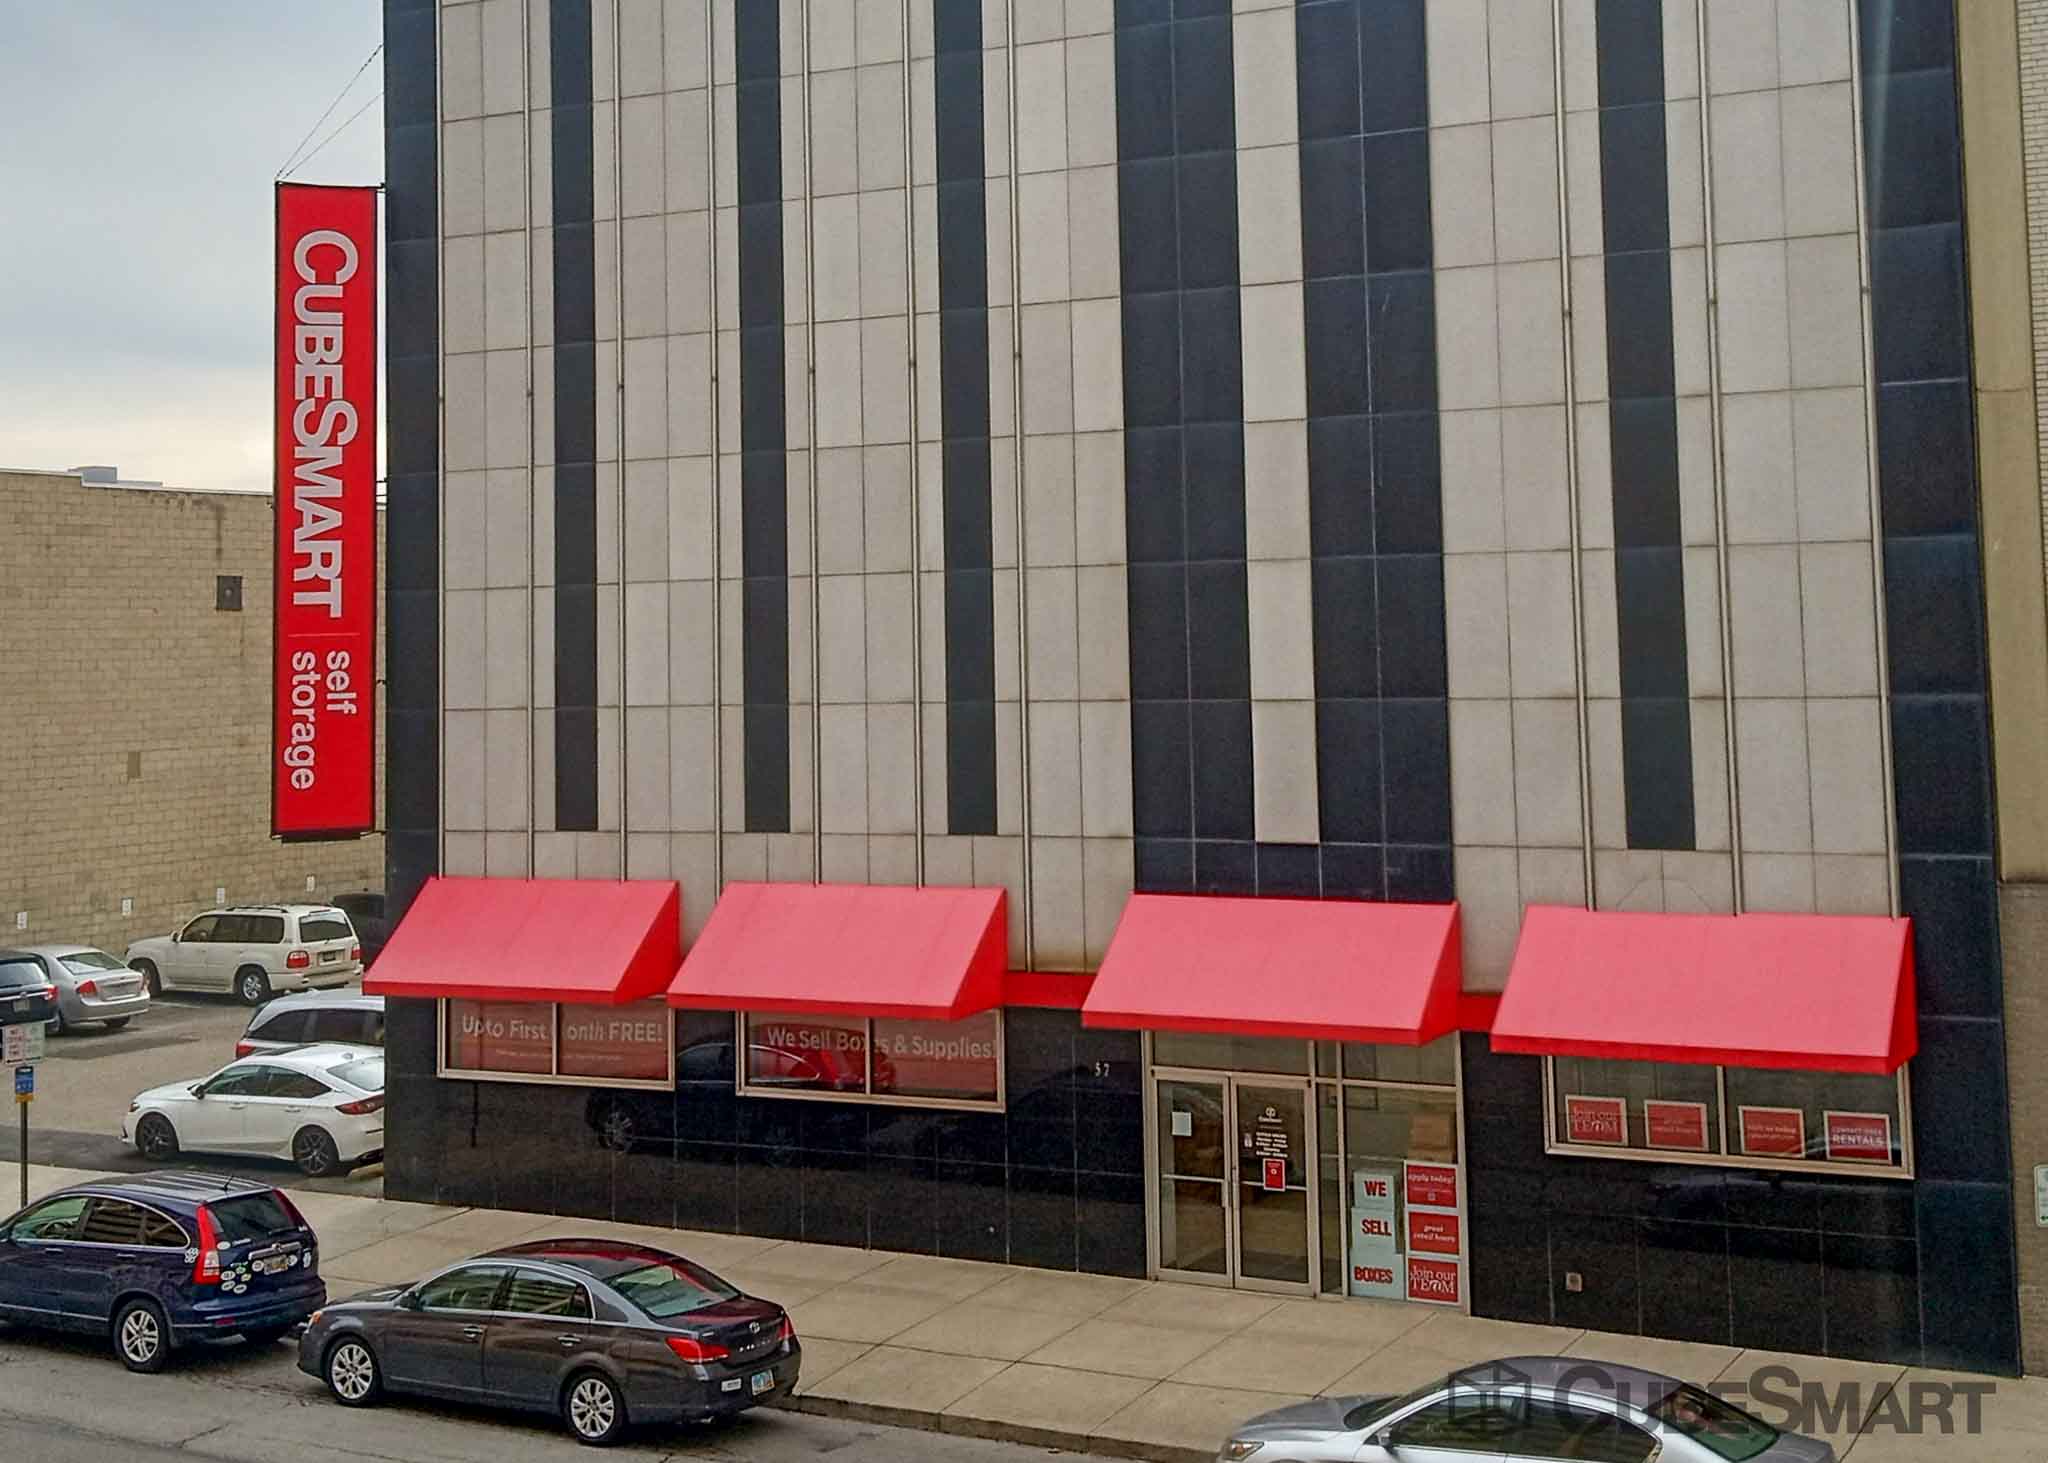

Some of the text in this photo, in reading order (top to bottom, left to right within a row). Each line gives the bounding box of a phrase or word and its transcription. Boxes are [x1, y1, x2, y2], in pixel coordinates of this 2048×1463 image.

[326, 651, 357, 714] self
[283, 651, 321, 790] storage
[509, 1019, 549, 1040] First
[562, 1018, 605, 1041] onth
[608, 1022, 663, 1042] FREE!
[767, 1027, 795, 1048] We
[800, 1029, 830, 1050] Sell
[894, 1033, 907, 1055] &
[1364, 1180, 1387, 1197] WE
[1361, 1219, 1392, 1237] SELL
[1354, 1265, 1393, 1284] BOXES
[1435, 1271, 1456, 1281] our
